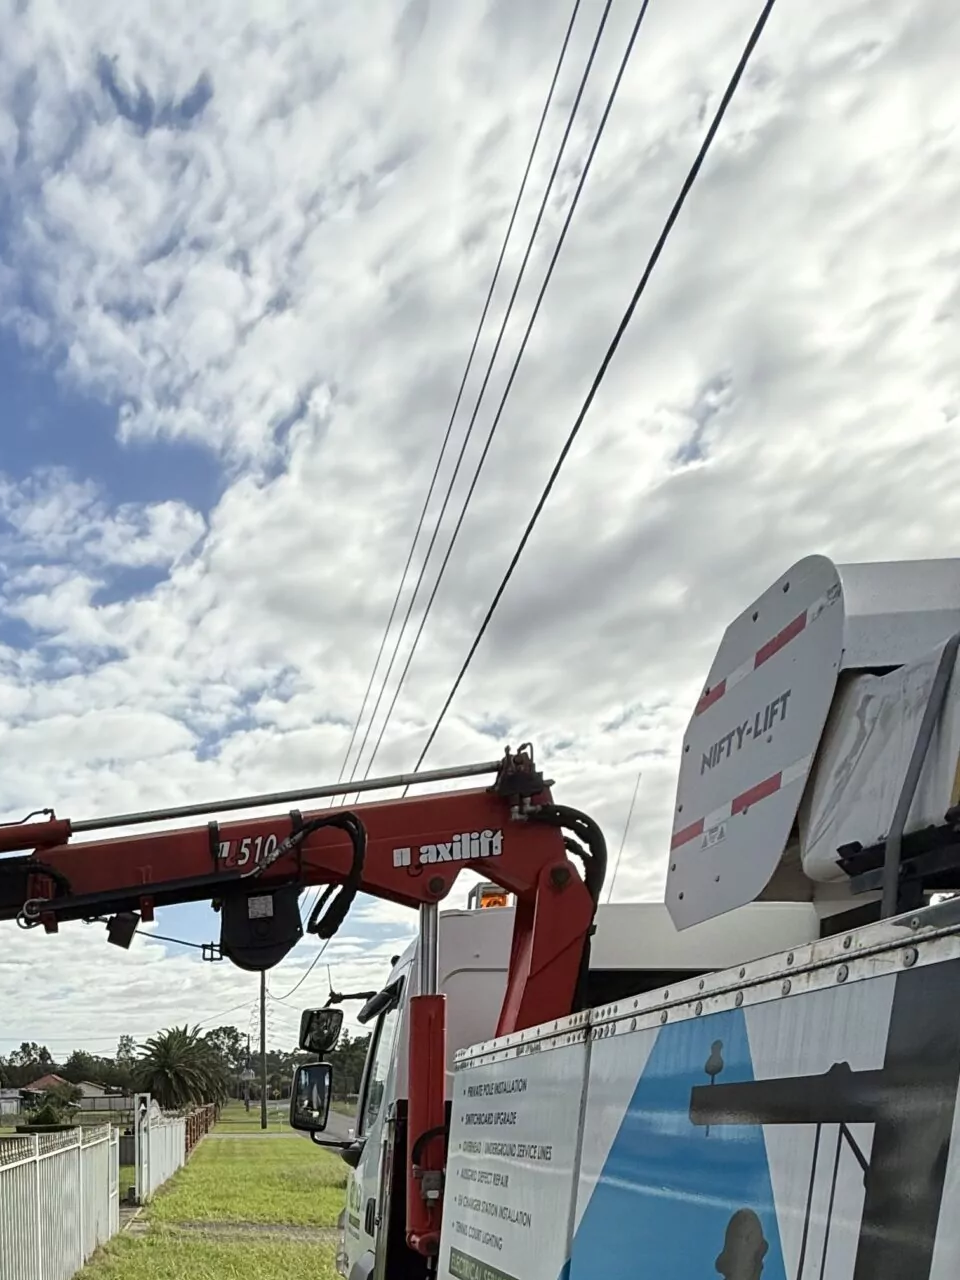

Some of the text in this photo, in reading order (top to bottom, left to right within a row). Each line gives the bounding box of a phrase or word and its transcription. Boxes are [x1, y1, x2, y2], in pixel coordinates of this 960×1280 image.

[700, 689, 792, 776] NIFTY-LIFT
[483, 1082, 494, 1096] POLE
[495, 1079, 527, 1095] INSTALLATION
[465, 1112, 517, 1125] SWITCHBOARD UPGRADE
[484, 1142, 516, 1157] UNDERGROUND
[517, 1144, 537, 1159] SERVICE
[538, 1146, 552, 1160] LINES
[499, 1206, 531, 1228] INSTALLATION
[482, 1233, 502, 1251] LIGHTING
